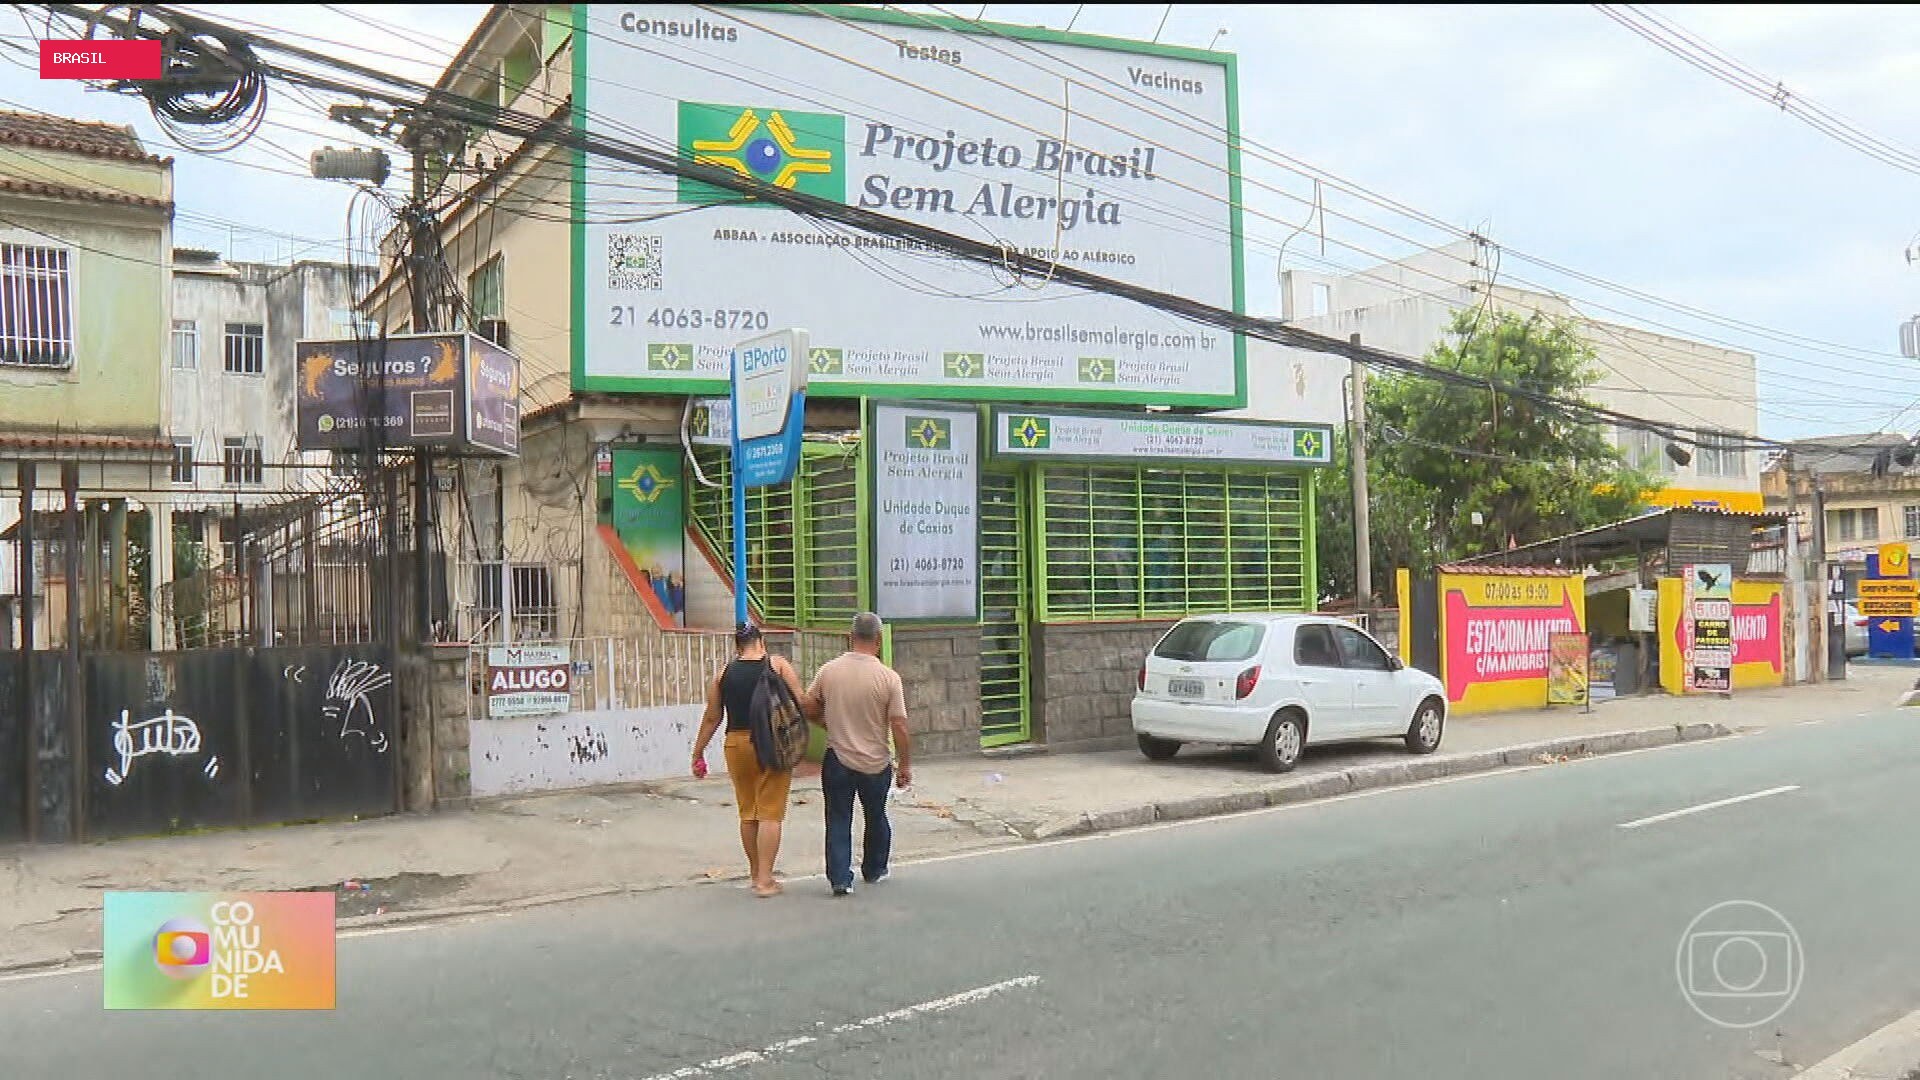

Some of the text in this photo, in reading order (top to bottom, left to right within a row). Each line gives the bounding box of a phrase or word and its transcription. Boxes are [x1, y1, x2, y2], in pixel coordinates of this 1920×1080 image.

[620, 12, 738, 42] Consultas
[896, 39, 962, 64] Testes
[1127, 66, 1203, 95] Vacinas
[859, 122, 1160, 181] Projeto Brasil
[858, 173, 1121, 231] Sem Alergia
[713, 228, 758, 242] ABBAA
[770, 230, 850, 249] ASSOCIAÇÃO
[1063, 250, 1078, 261] AO
[1082, 248, 1136, 265] ALÉRGICO
[610, 305, 769, 331] 21 4063-8720
[978, 320, 1217, 351] www.brasilsemalergia.combr
[420, 355, 432, 374] ?
[754, 344, 787, 370] Porto
[884, 450, 969, 465] Projeto Brasil
[887, 464, 914, 478] Sem
[883, 499, 970, 518] Unidade Duque
[900, 520, 953, 535] de Caxias
[890, 557, 964, 573] (21) 4063-8720
[1706, 629, 1718, 637] DE
[491, 669, 567, 691] ALUGO
